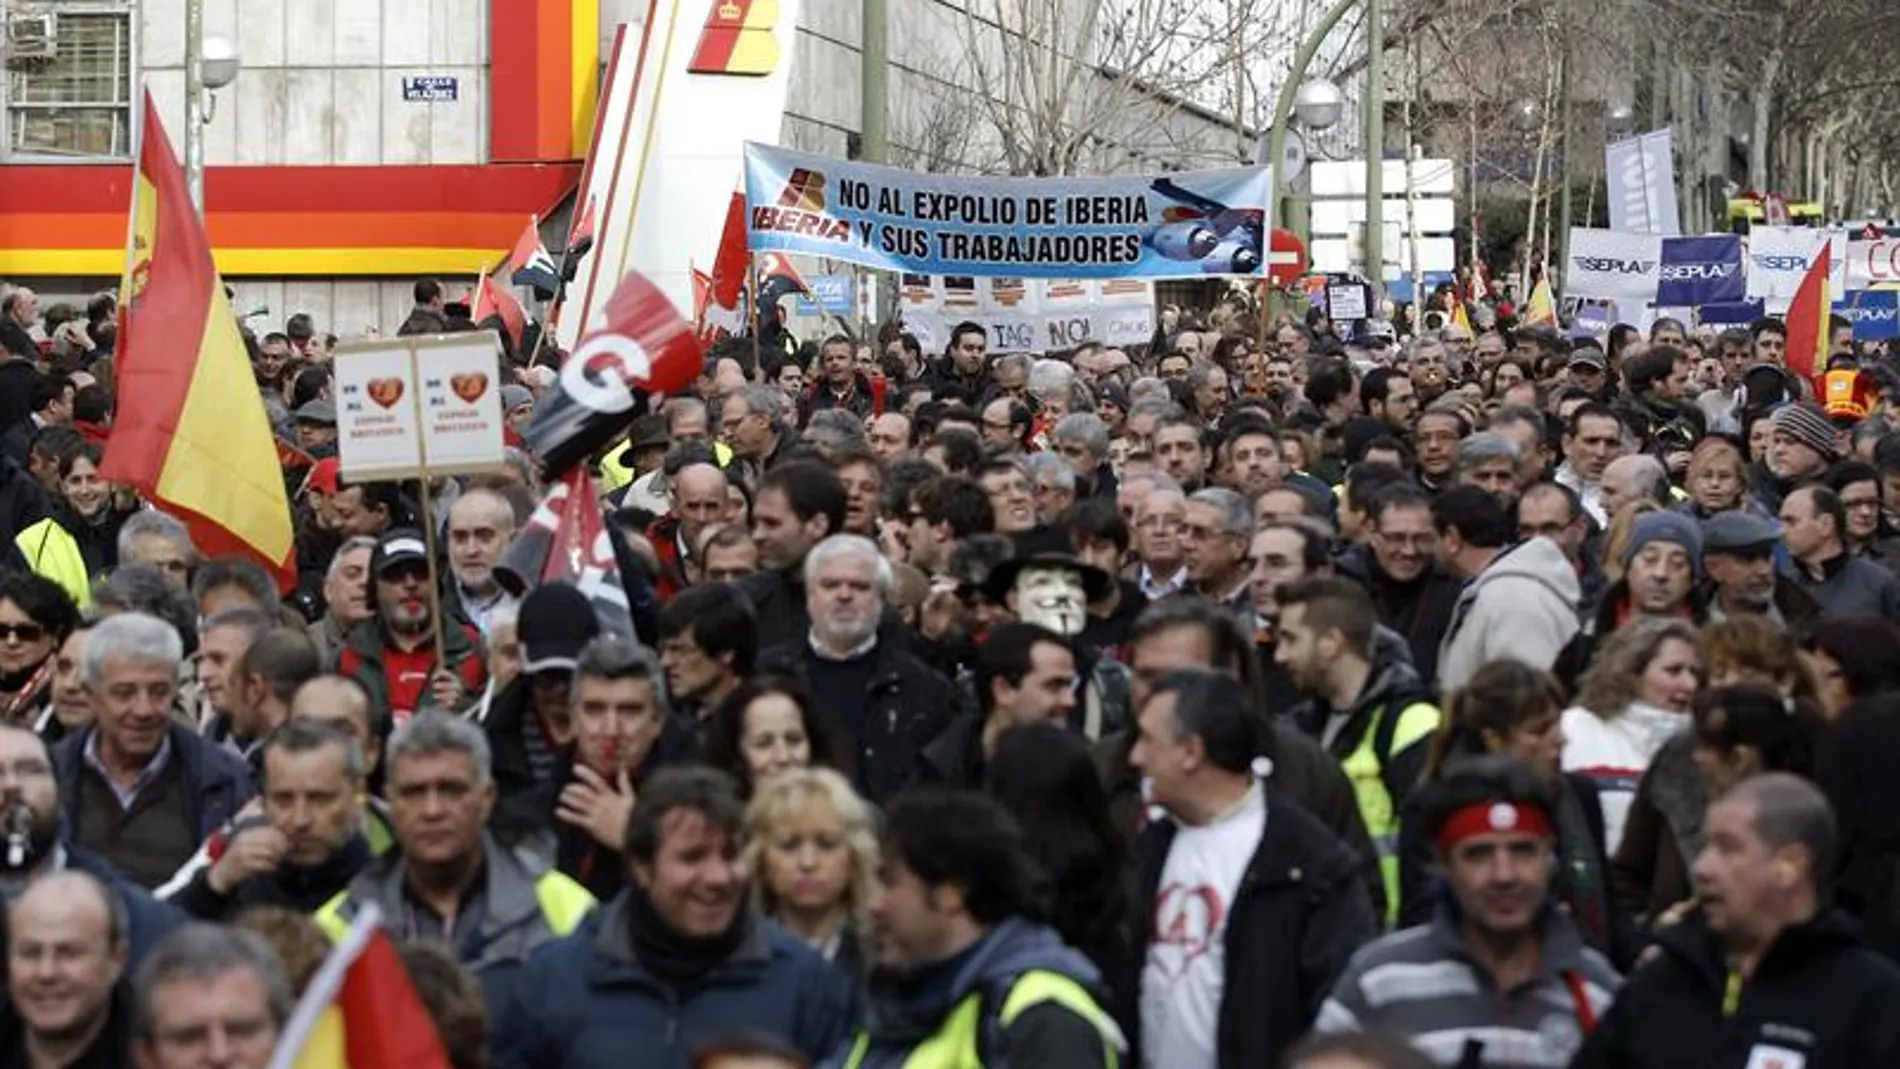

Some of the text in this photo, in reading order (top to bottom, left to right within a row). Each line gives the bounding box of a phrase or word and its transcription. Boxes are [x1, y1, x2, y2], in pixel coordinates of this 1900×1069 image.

[839, 179, 1149, 225] NO AL EXPOLIO DE IBERIA
[752, 206, 852, 243] IBERIA
[859, 221, 1140, 263] Y SUS TRABAJADORES
[1586, 256, 1642, 274] SEPLA
[1658, 263, 1725, 280] SEPLA
[1765, 255, 1813, 271] SEPL
